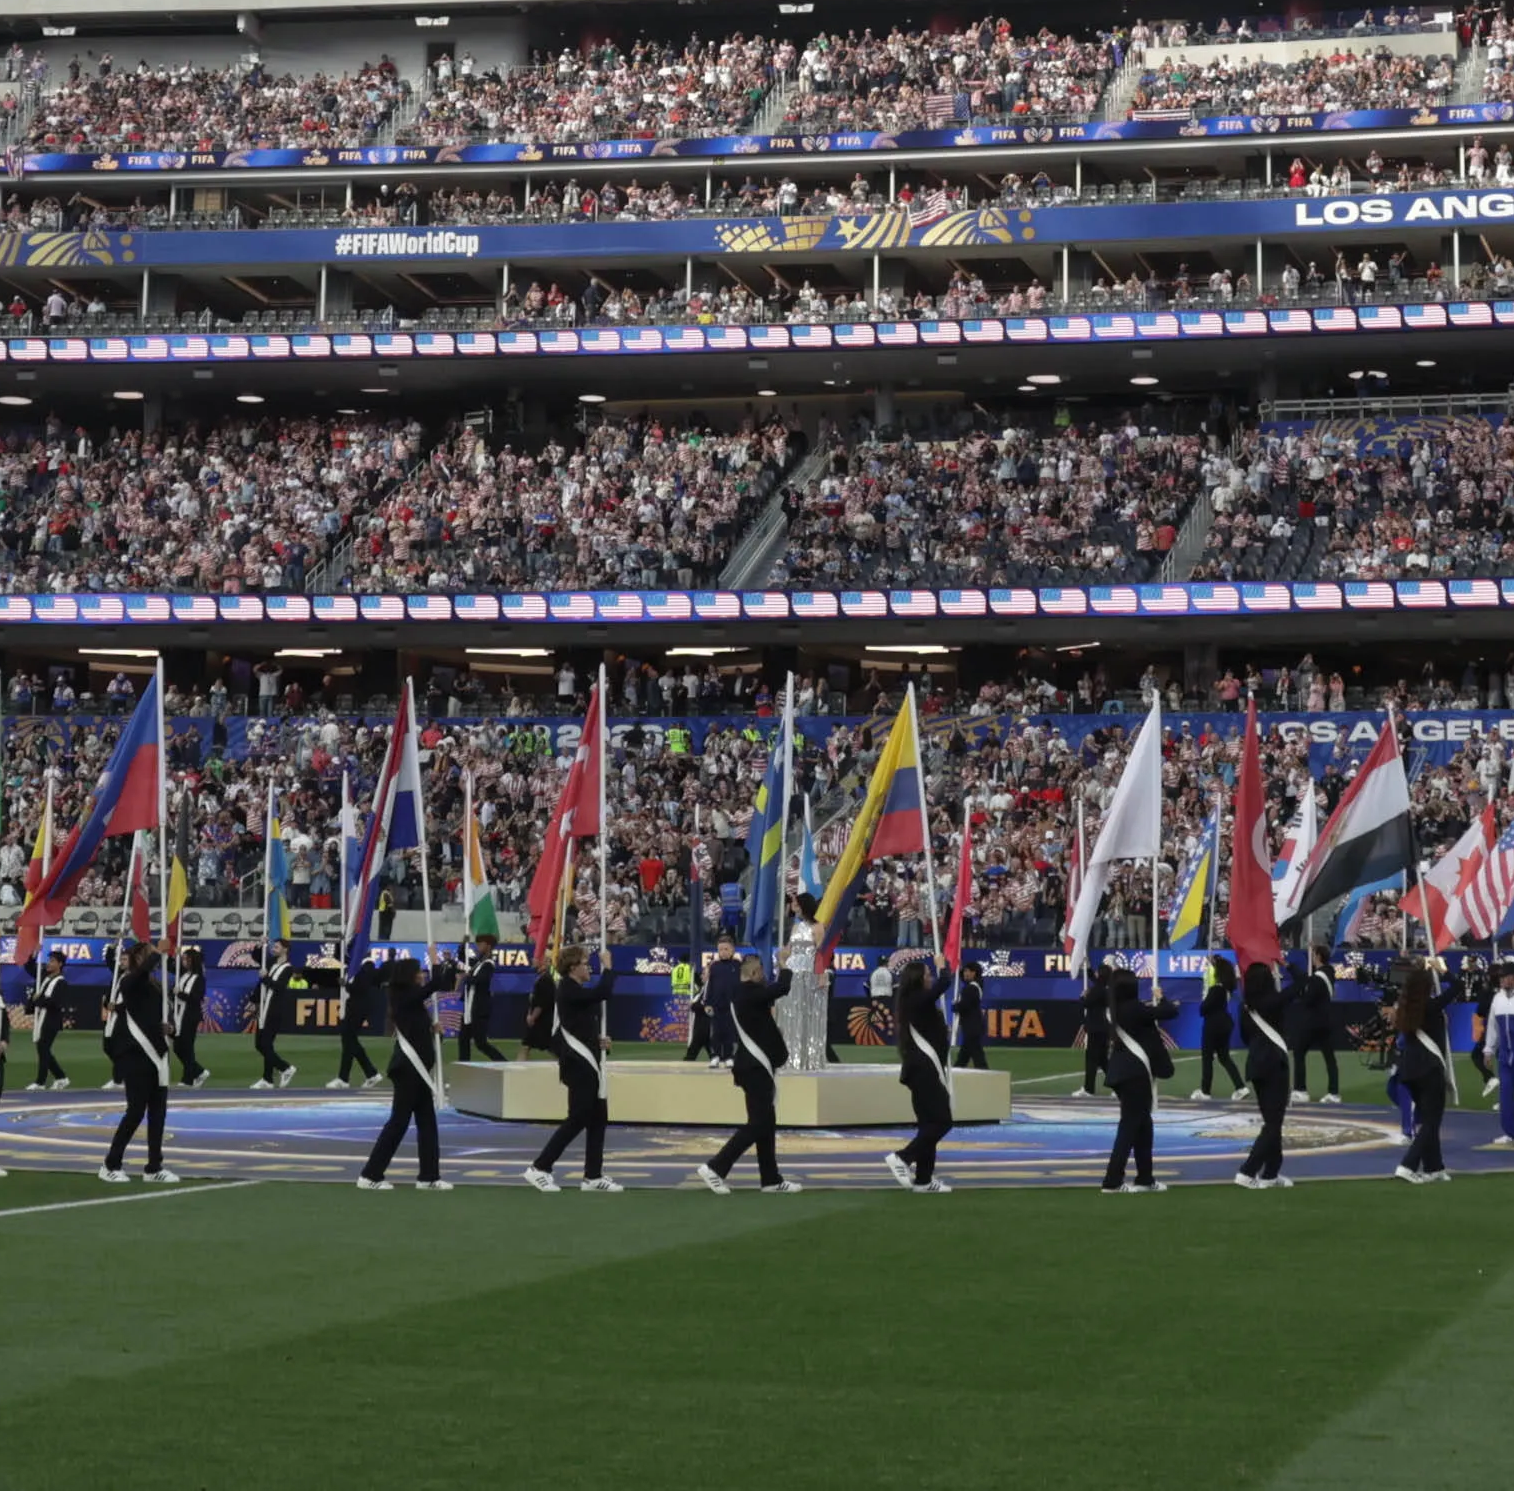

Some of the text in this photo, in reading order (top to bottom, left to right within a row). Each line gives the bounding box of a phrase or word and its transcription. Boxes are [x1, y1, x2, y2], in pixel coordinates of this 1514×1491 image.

[1449, 109, 1475, 119] FIFA
[1218, 120, 1244, 130] FIFA
[1287, 117, 1313, 127] FIFA
[991, 130, 1016, 140] FIFA
[1059, 127, 1085, 137] FIFA
[770, 139, 795, 148] FIFA
[837, 136, 862, 146] FIFA
[553, 146, 577, 155] FIFA
[618, 144, 642, 153] FIFA
[191, 155, 215, 164] FIFA
[339, 151, 363, 161] FIFA
[403, 150, 427, 159] FIFA
[128, 156, 152, 165] FIFA
[1296, 199, 1393, 226] LOS
[335, 231, 479, 257] #FIFAWorldCup
[834, 954, 865, 970] IFA
[988, 1010, 1045, 1038] IFA
